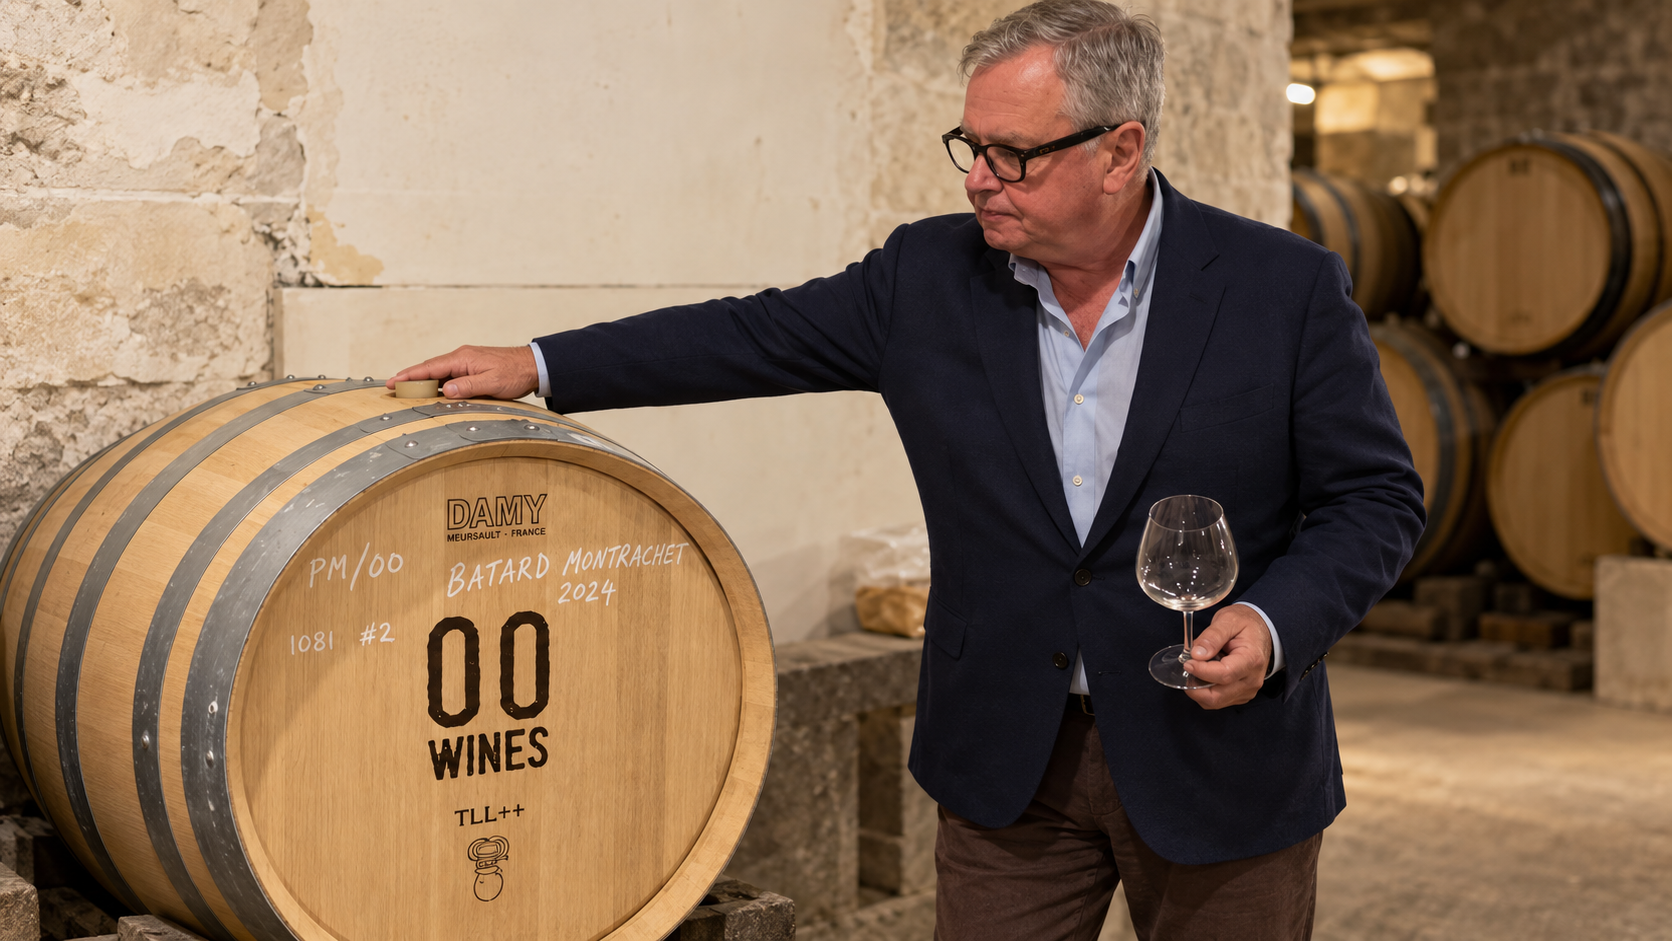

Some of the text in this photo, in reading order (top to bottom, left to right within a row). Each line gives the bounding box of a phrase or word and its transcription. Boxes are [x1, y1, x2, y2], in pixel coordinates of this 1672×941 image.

[446, 493, 548, 530] DAMY
[446, 531, 502, 543] MEURSAULT
[511, 527, 546, 538] FRANCE
[446, 541, 690, 598] BATARD MONTRACHET
[557, 578, 617, 607] 2024
[290, 621, 396, 656] 1081 #2
[427, 726, 549, 781] WINES
[454, 803, 526, 827] TLL++
